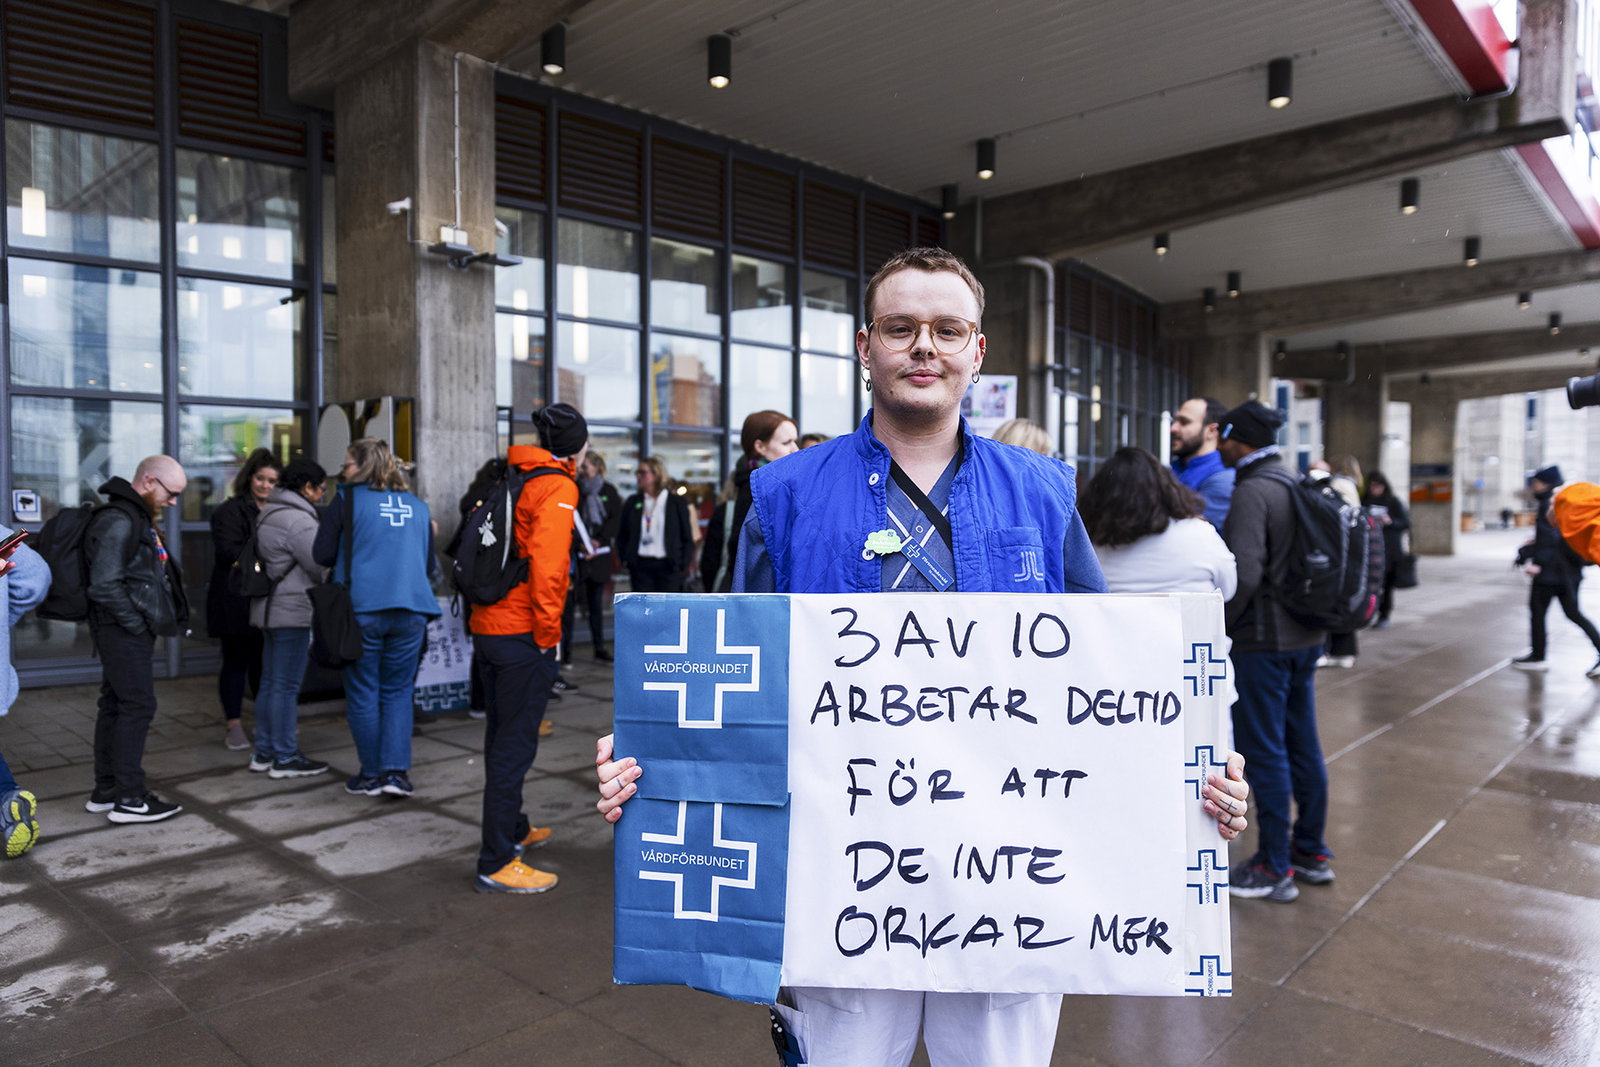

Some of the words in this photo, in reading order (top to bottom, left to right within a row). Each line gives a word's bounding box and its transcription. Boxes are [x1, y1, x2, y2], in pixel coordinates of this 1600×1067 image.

[830, 607, 881, 668] 3
[894, 610, 978, 659] AV
[1012, 611, 1071, 659] 10
[644, 659, 749, 674] VÅRDFÖRBUNDET
[810, 680, 1038, 727] ARBETAR
[1066, 685, 1182, 727] DELTID
[846, 757, 965, 817] FÖR
[1000, 767, 1089, 799] ATT
[641, 848, 745, 870] VÅRDFÖRBUNDET
[844, 840, 929, 892] DE
[953, 843, 1066, 885] INTE
[834, 905, 1075, 959] ORKAR
[1089, 913, 1173, 956] MER
